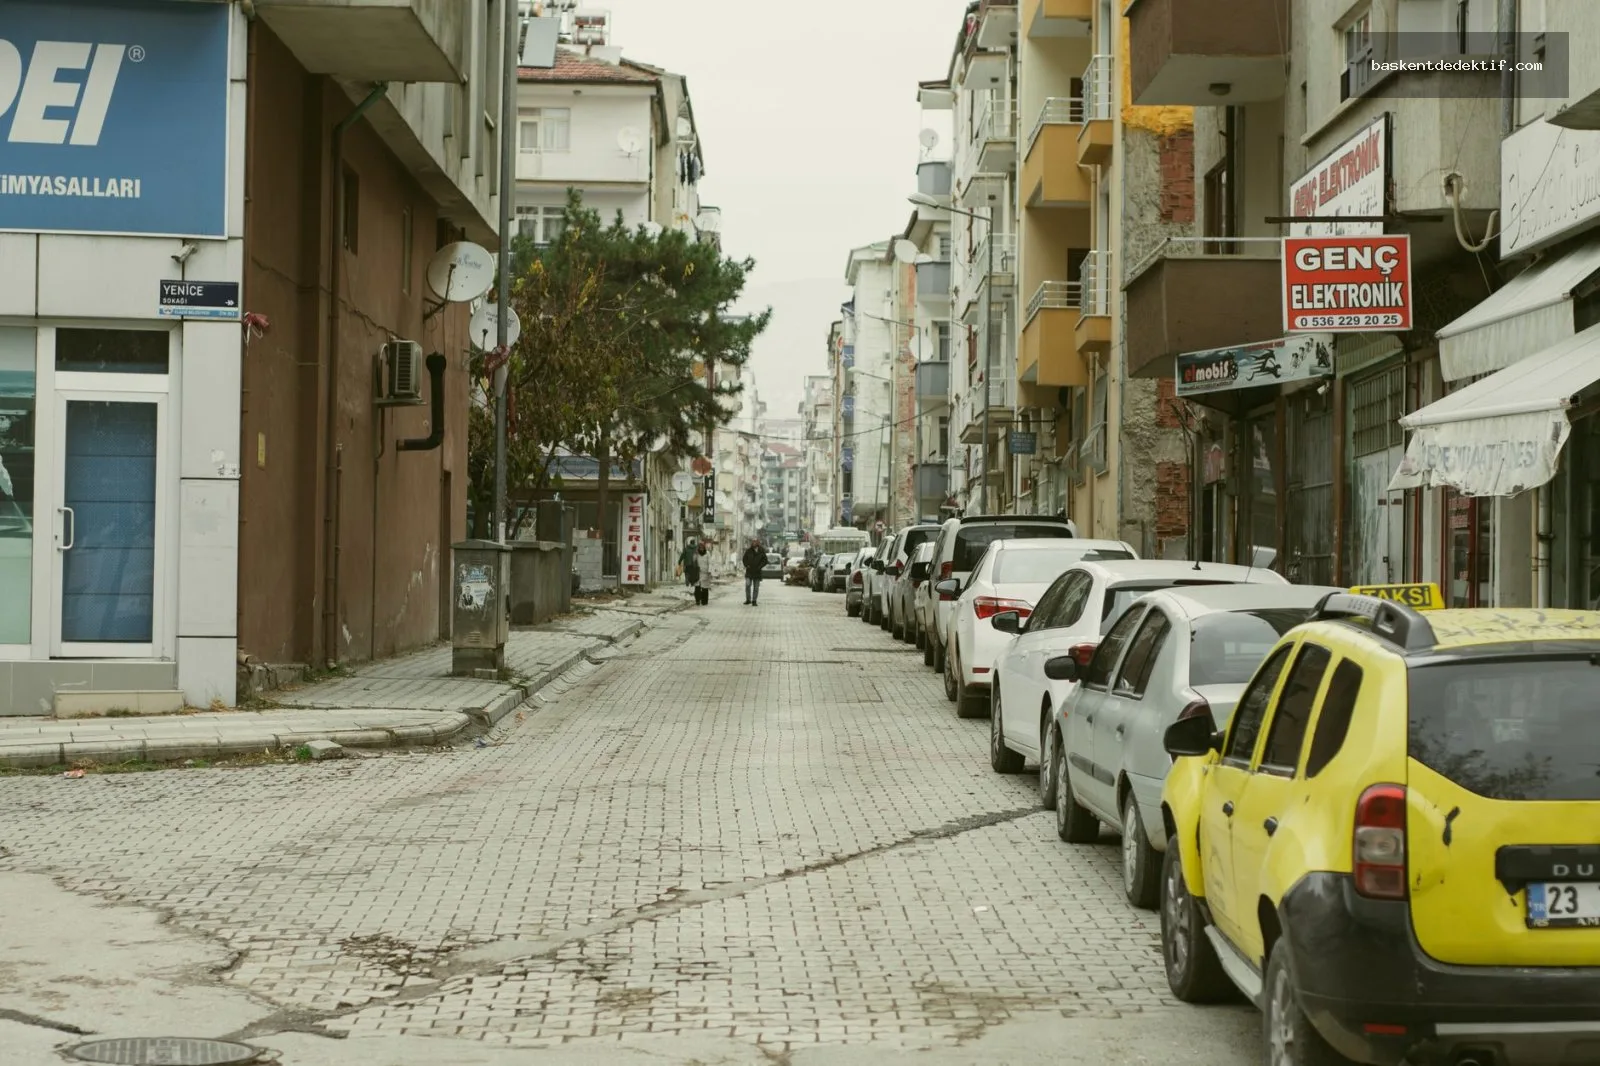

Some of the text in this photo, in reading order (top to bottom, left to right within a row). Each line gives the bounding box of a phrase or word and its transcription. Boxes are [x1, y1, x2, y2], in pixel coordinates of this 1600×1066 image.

[1295, 245, 1399, 275] GENÇ
[162, 283, 204, 297] YENİCE
[1291, 276, 1404, 310] ELEKTRONİK
[1300, 314, 1398, 327] 0 536 229 20 25
[1548, 886, 1579, 914] 23
